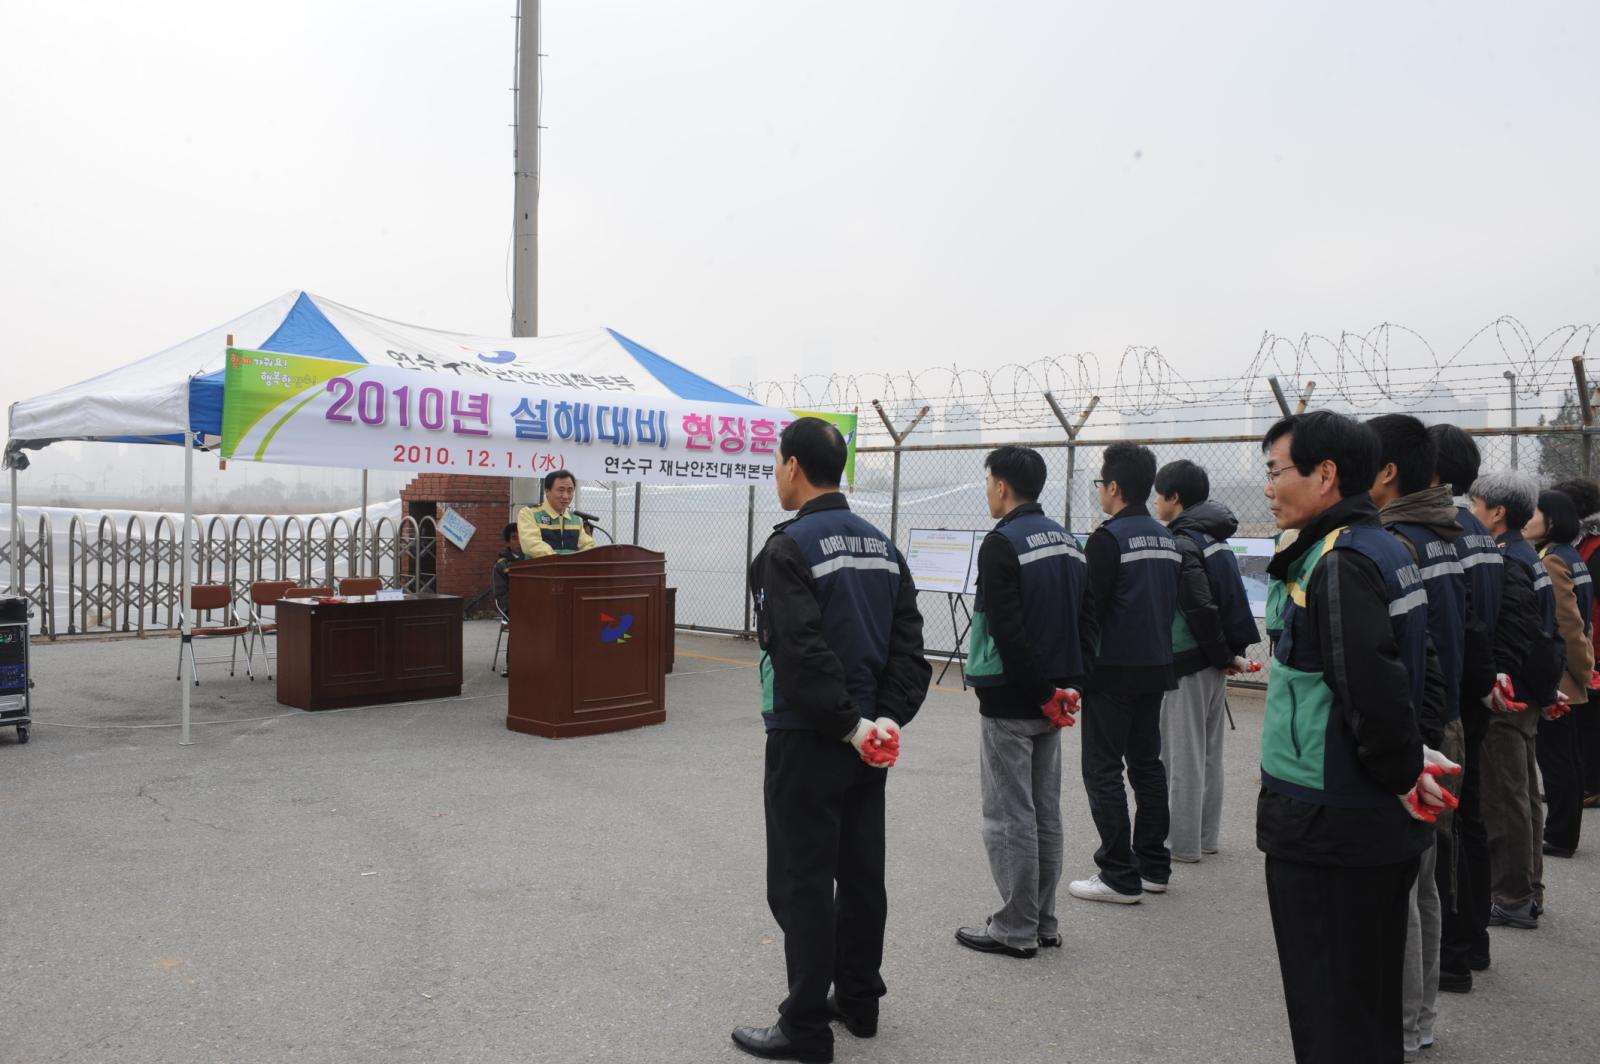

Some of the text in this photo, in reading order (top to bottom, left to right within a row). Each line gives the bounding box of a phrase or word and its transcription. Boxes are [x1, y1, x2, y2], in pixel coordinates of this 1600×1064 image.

[324, 376, 491, 437] 2010년
[510, 397, 667, 449] 설해대비
[393, 444, 565, 472] 2010. 12. 1. (水)
[604, 455, 775, 481] 연수구 재난안전대책본부
[819, 535, 847, 555] KOREA
